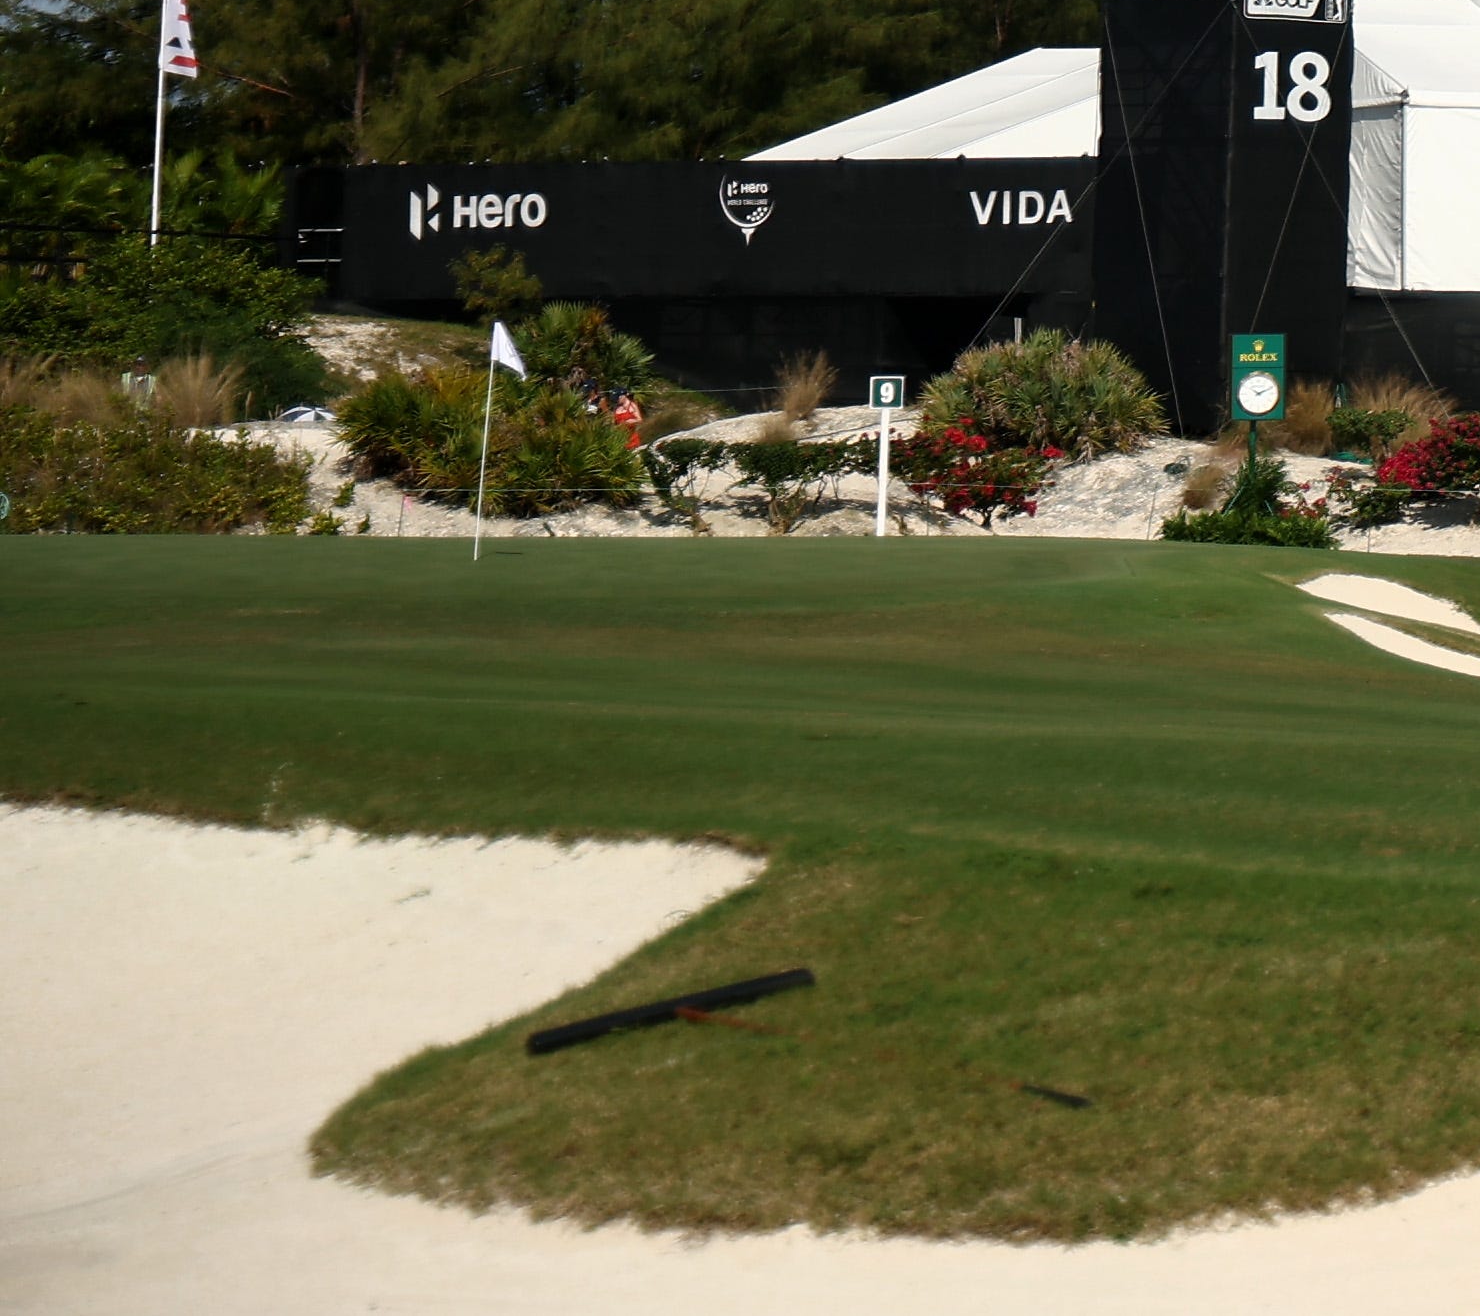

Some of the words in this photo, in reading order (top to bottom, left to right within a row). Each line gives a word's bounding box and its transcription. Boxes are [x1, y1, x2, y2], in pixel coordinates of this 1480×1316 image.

[1253, 51, 1332, 122] 18
[741, 183, 768, 194] Hero
[452, 193, 547, 229] Hero
[969, 189, 1073, 225] VIDA
[1239, 353, 1278, 362] ROLEX
[880, 382, 895, 404] 9
